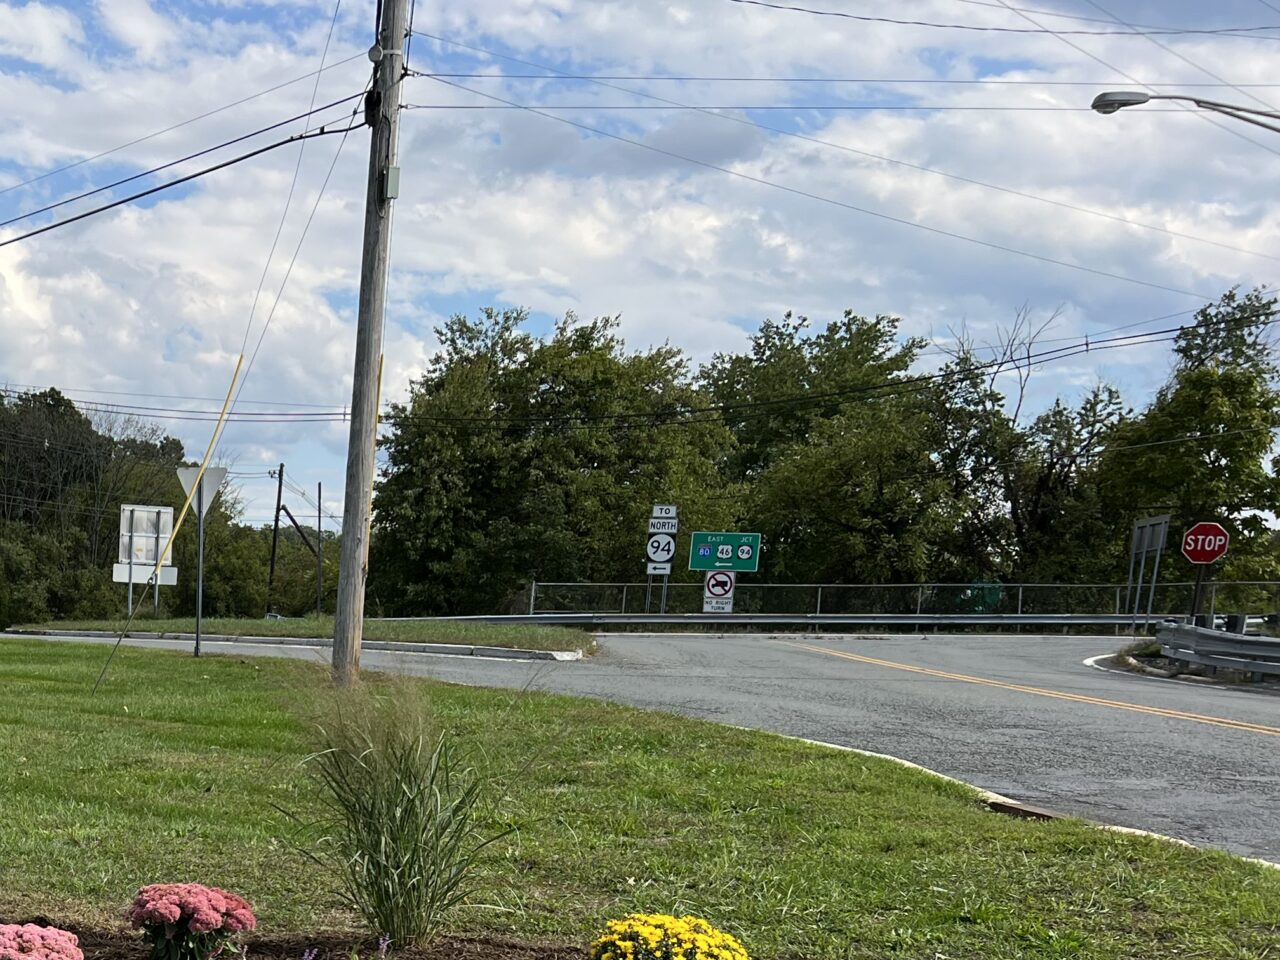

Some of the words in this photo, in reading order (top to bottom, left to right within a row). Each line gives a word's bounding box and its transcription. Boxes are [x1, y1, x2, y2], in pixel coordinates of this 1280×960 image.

[650, 522, 676, 530] NORTH
[650, 540, 672, 555] 94
[1186, 536, 1225, 550] STOP
